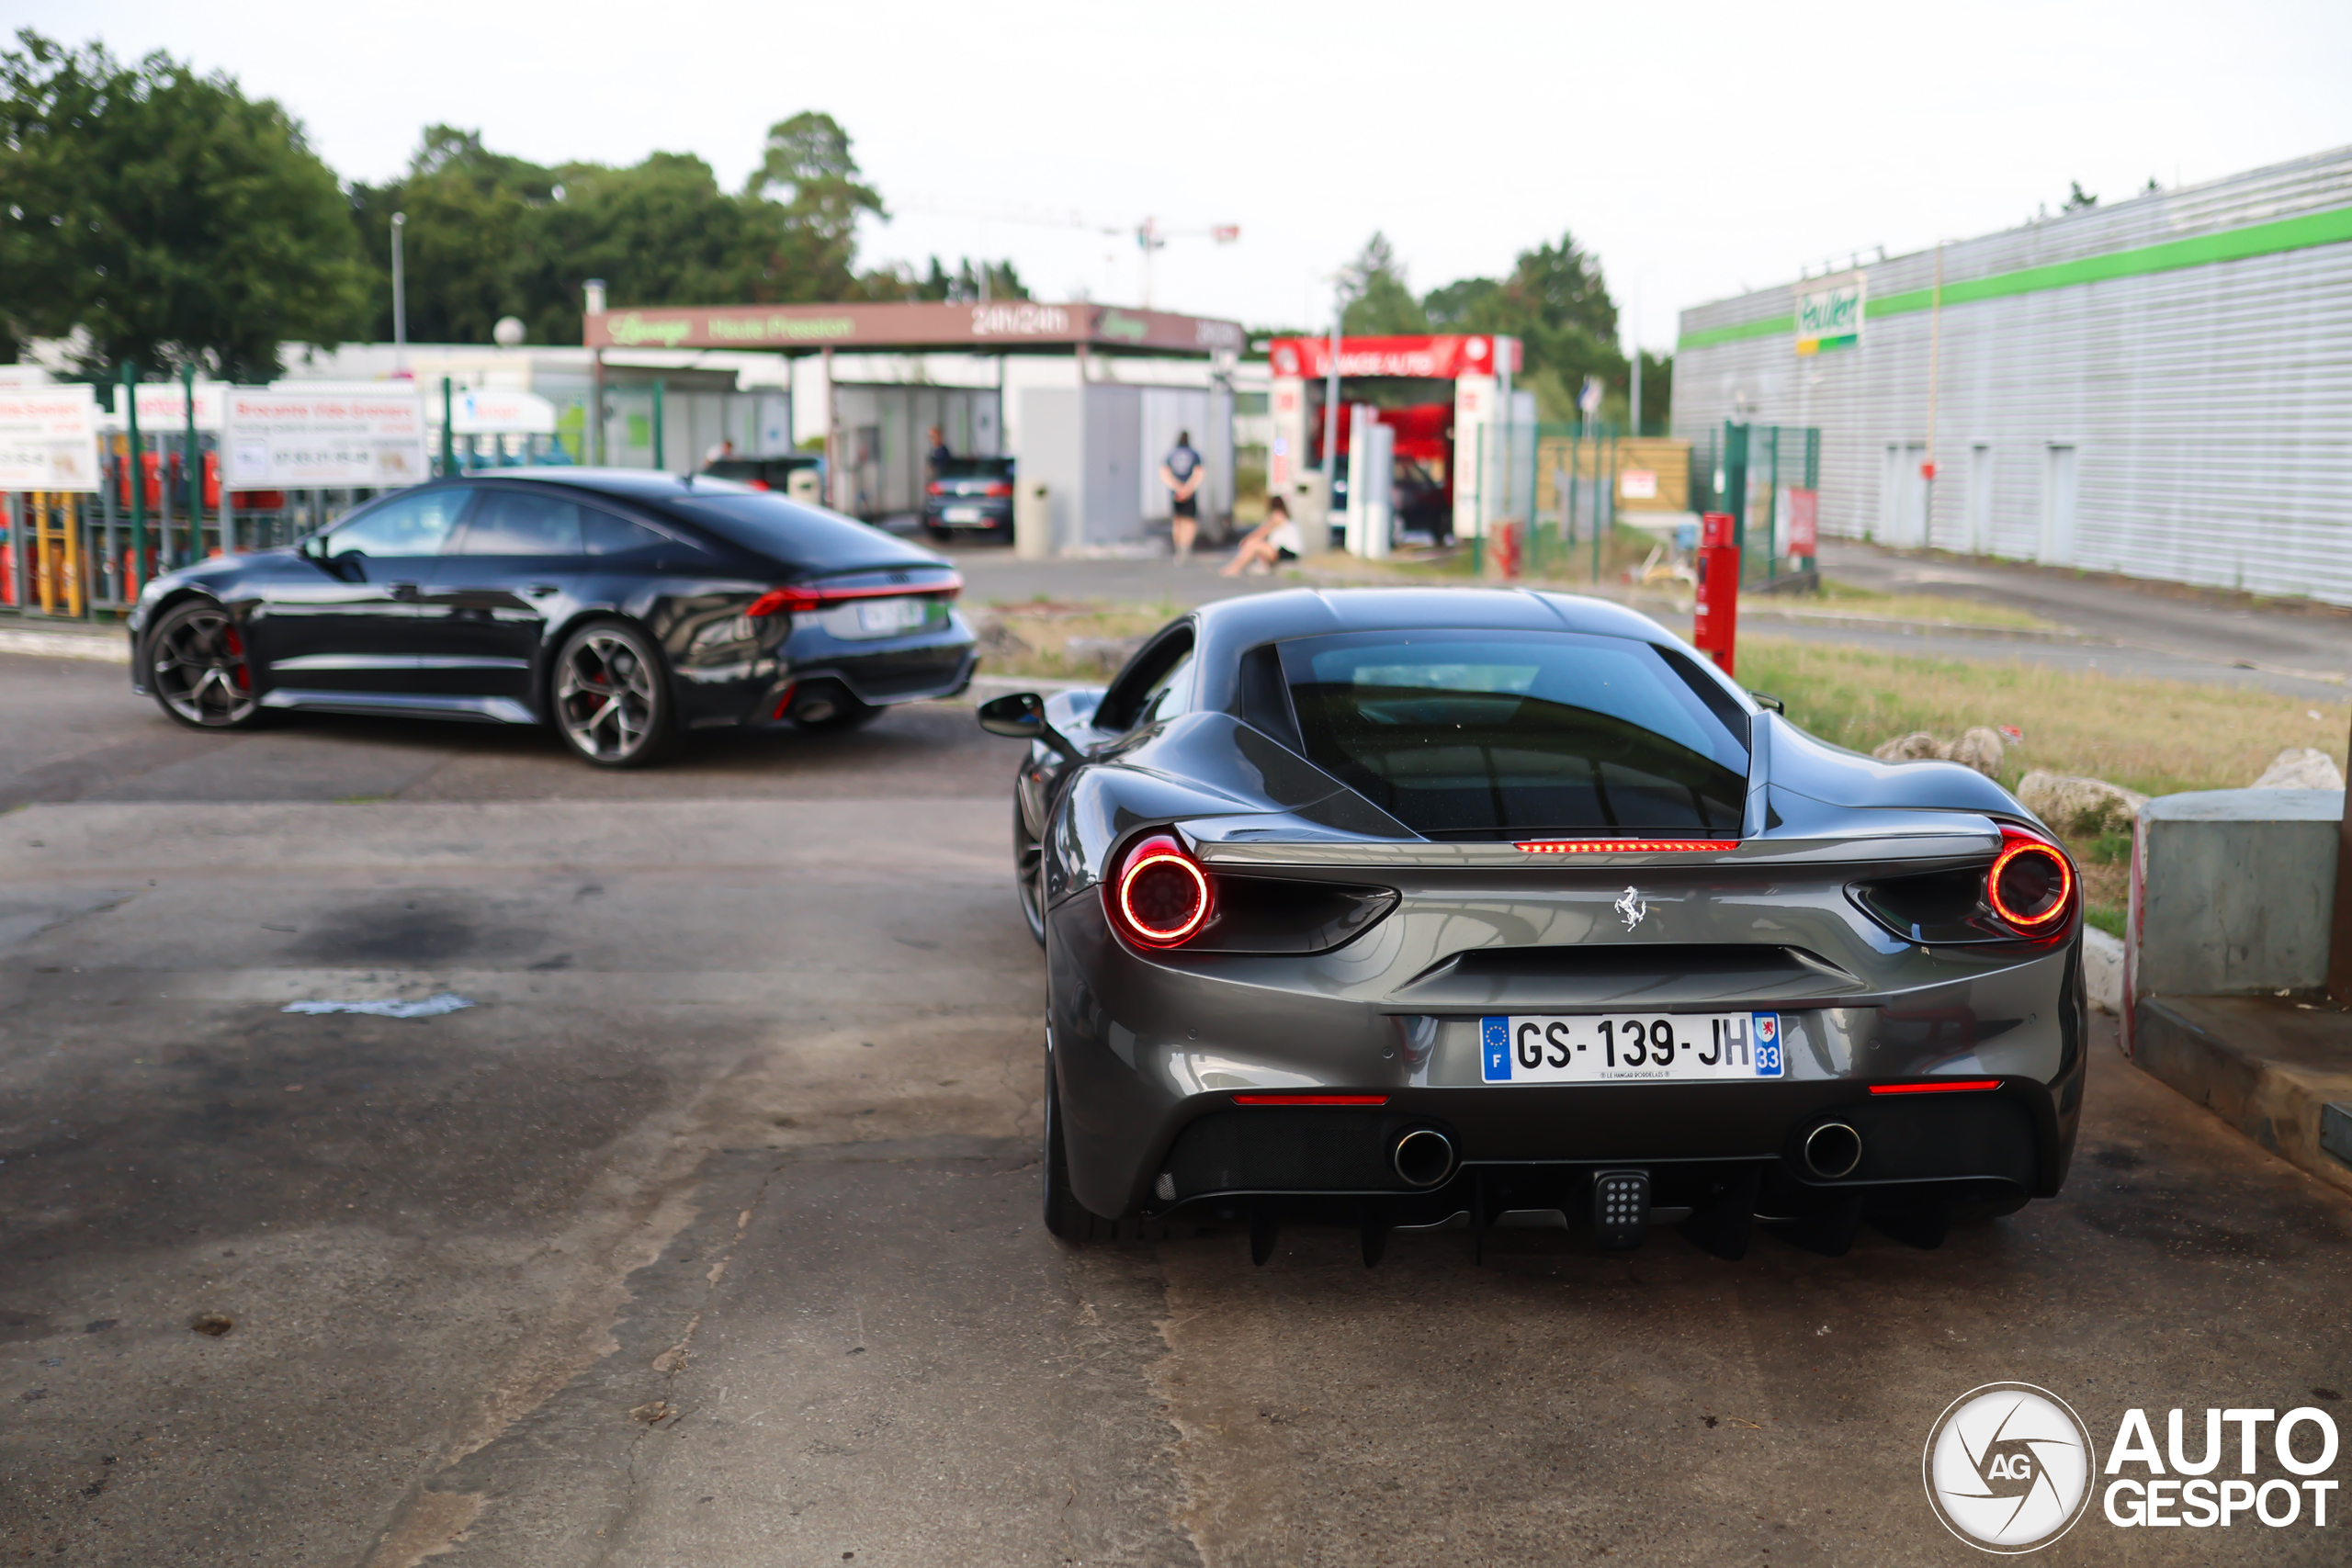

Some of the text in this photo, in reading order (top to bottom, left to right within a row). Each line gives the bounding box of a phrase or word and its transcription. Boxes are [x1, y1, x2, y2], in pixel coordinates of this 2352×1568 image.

[767, 314, 854, 339] Pression
[972, 304, 1068, 334] 24h/24h
[1516, 1018, 1749, 1069] GS-139-JH
[1493, 1055, 1501, 1067] F
[1756, 1046, 1780, 1068] 33
